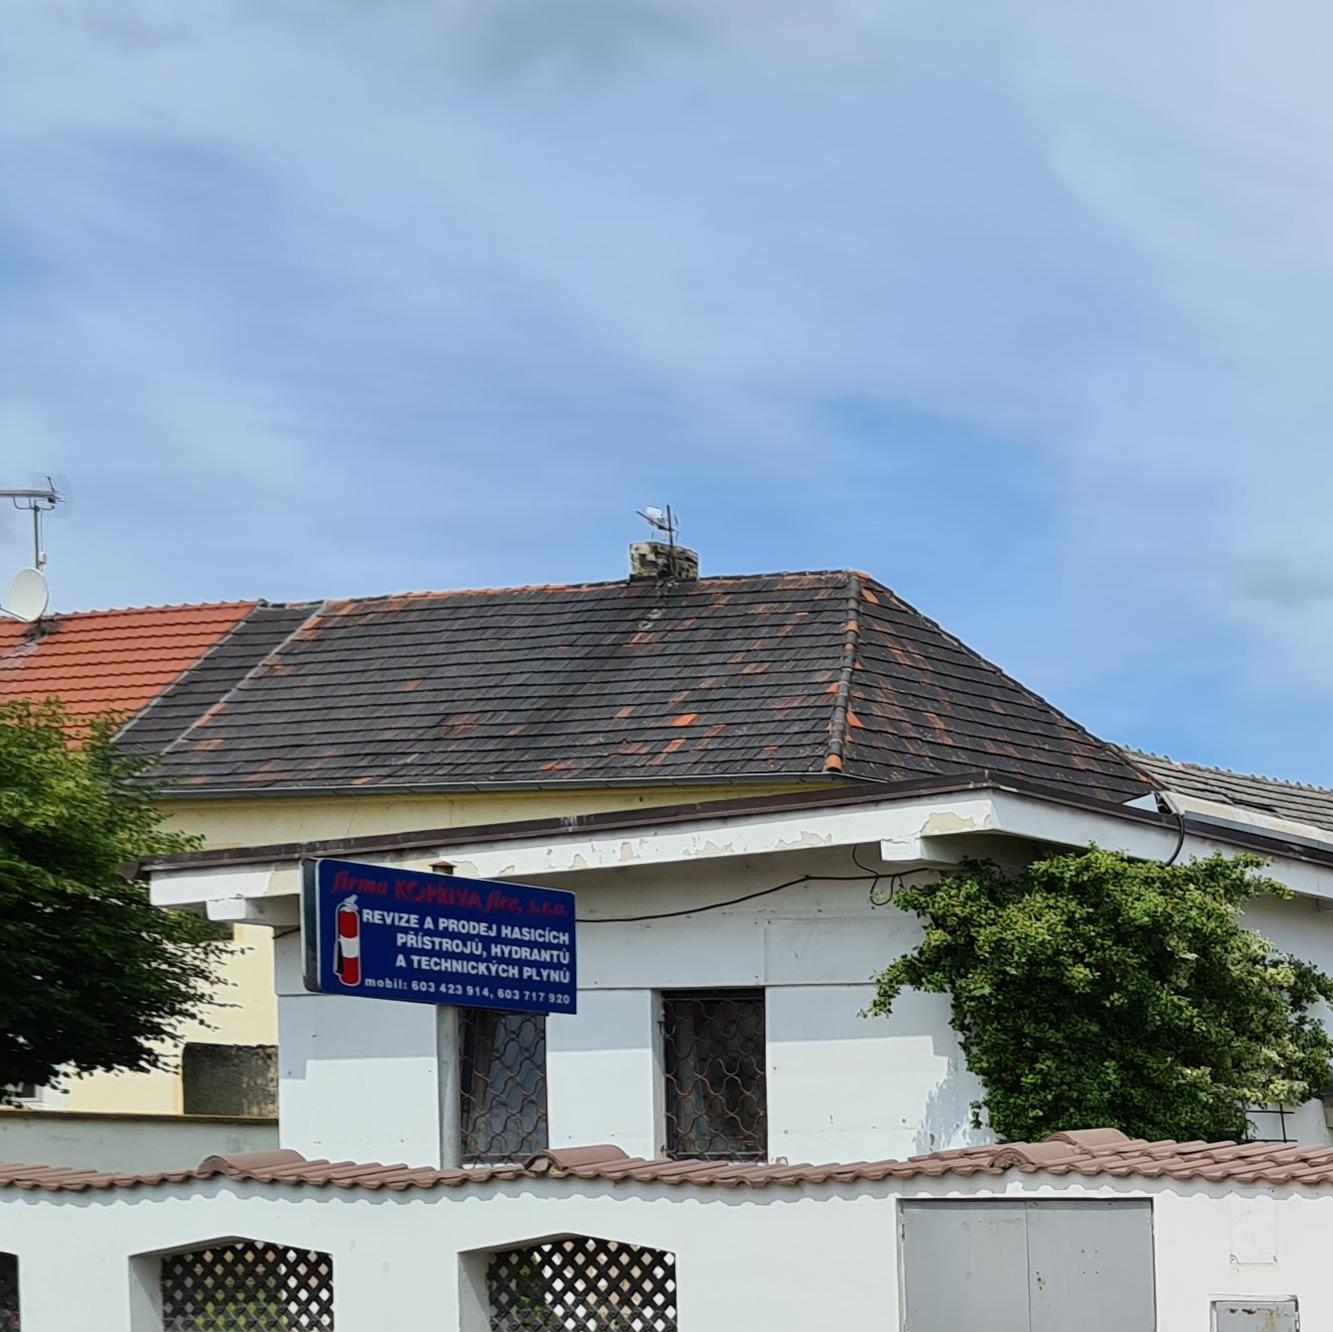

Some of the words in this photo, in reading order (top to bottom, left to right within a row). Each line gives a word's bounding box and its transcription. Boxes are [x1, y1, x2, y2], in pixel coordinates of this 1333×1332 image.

[362, 909, 420, 928] REVIZE
[423, 916, 434, 930] A
[438, 917, 497, 937] PRODEJ
[501, 925, 569, 945] HASICÍCH
[396, 930, 487, 958] PŘÍSTROJŮ,
[491, 943, 570, 964] HYDRANTŮ
[395, 954, 407, 968] A
[410, 955, 519, 979] TECHNICKÝCH
[523, 966, 570, 983] PLYNŮ
[364, 978, 408, 990] mobil:
[411, 980, 436, 992] 603
[439, 983, 463, 995] 423
[466, 985, 494, 1000] 914,
[497, 988, 520, 1000] 603
[523, 990, 545, 1002] 717
[548, 992, 570, 1004] 920
